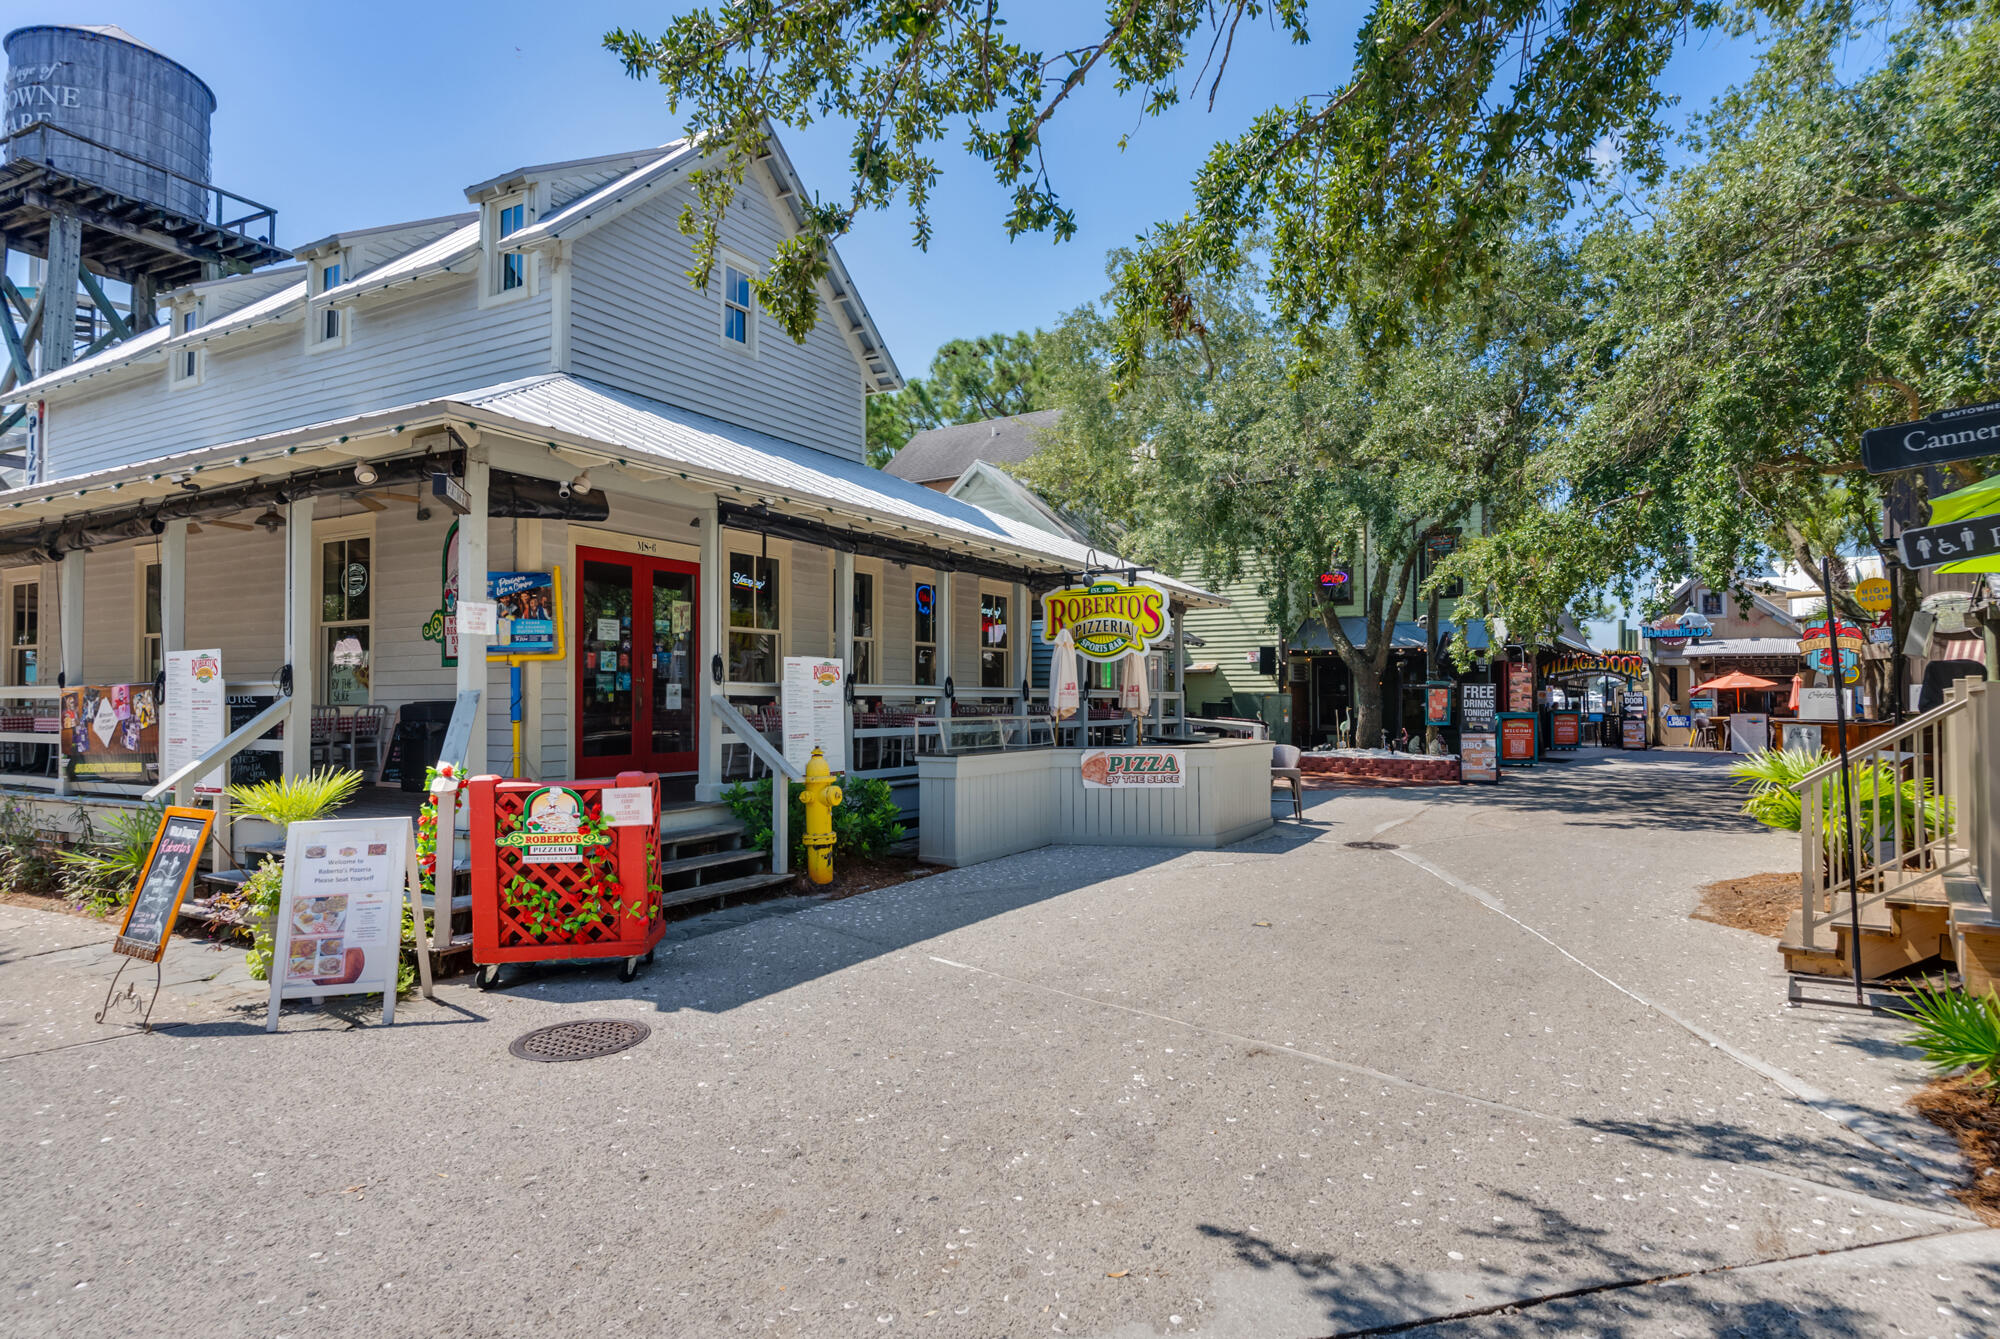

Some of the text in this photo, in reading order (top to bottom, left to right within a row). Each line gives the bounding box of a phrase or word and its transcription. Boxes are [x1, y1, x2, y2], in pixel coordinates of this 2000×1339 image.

[40, 62, 62, 81] of
[1320, 573, 1345, 584] OPEN
[1861, 586, 1889, 595] HIGH
[1861, 594, 1892, 602] NOON
[1048, 594, 1160, 637] ROBERTO'S
[1075, 619, 1132, 638] PIZZERIA
[1080, 637, 1126, 652] SPORTS BAR
[1541, 655, 1643, 680] VILLAGE DOOR
[1741, 659, 1797, 668] OYSTER
[1755, 667, 1781, 675] BAR
[1463, 685, 1495, 699] FREE
[1463, 699, 1495, 708] DRINKS
[1463, 708, 1494, 717] TONIGHT
[1107, 755, 1178, 773] PIZZA
[1106, 775, 1180, 784] BY THE SLICE
[525, 835, 582, 844] ROBERTO'S
